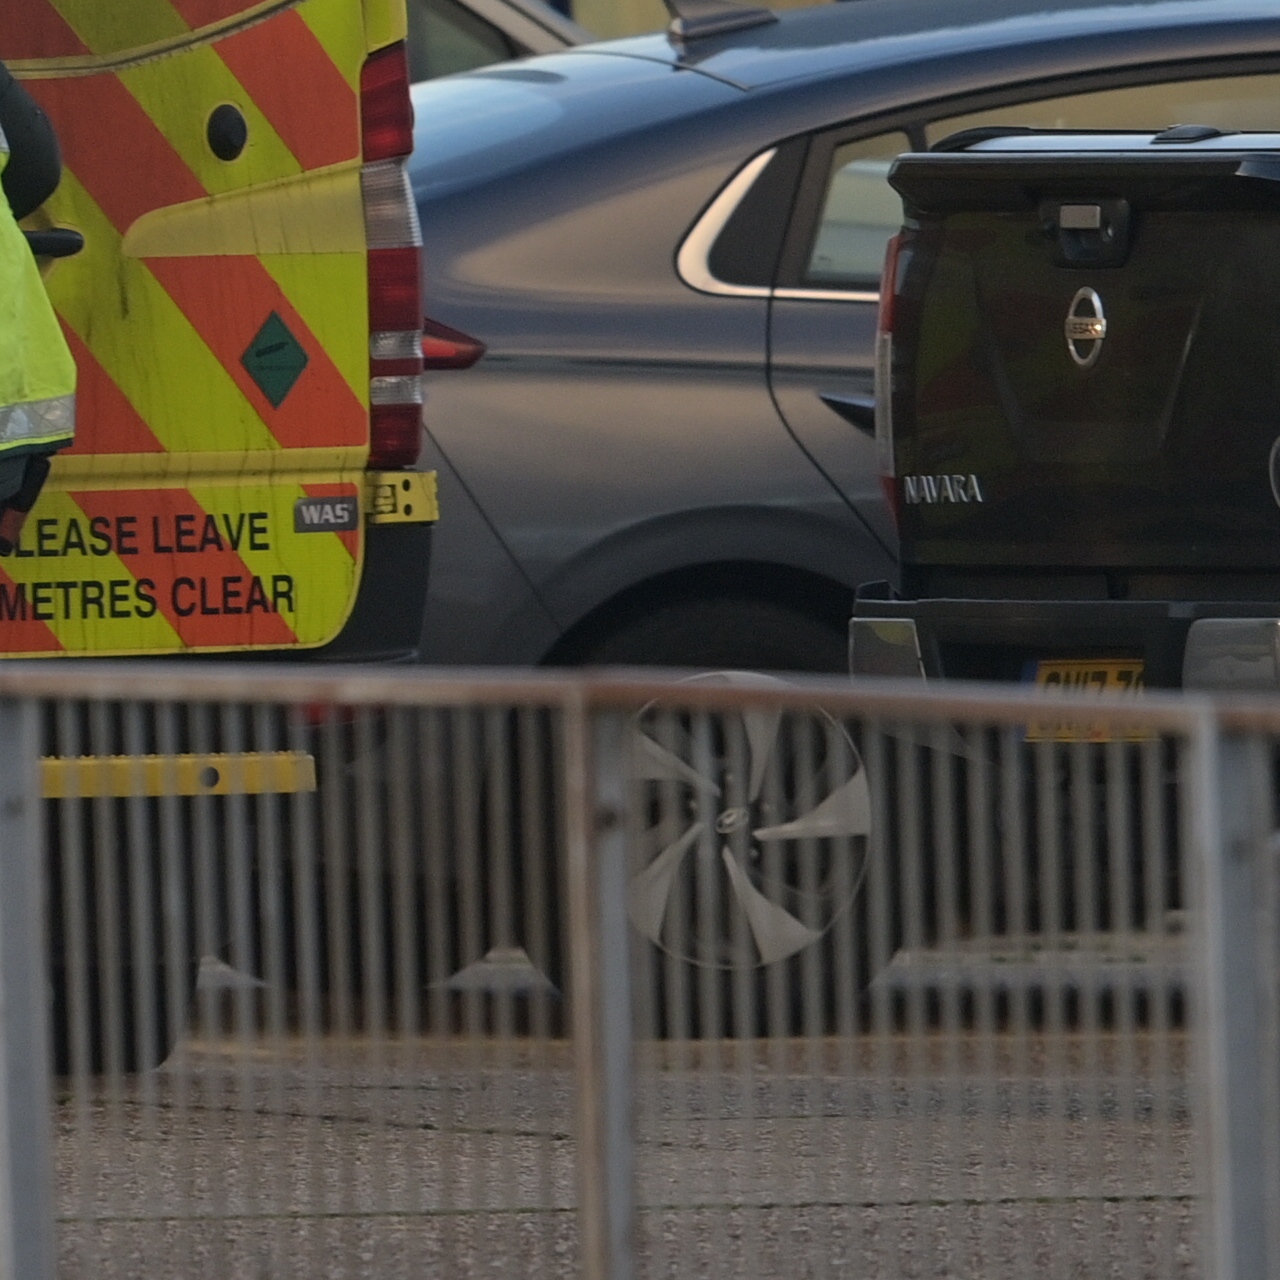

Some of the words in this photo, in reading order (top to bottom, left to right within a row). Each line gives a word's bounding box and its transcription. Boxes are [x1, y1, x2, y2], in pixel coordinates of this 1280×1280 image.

[904, 474, 983, 504] NAVARA
[301, 504, 349, 524] WAS
[8, 516, 139, 558] LEASE
[152, 511, 271, 554] LEAVE
[171, 574, 296, 618] CLEAR
